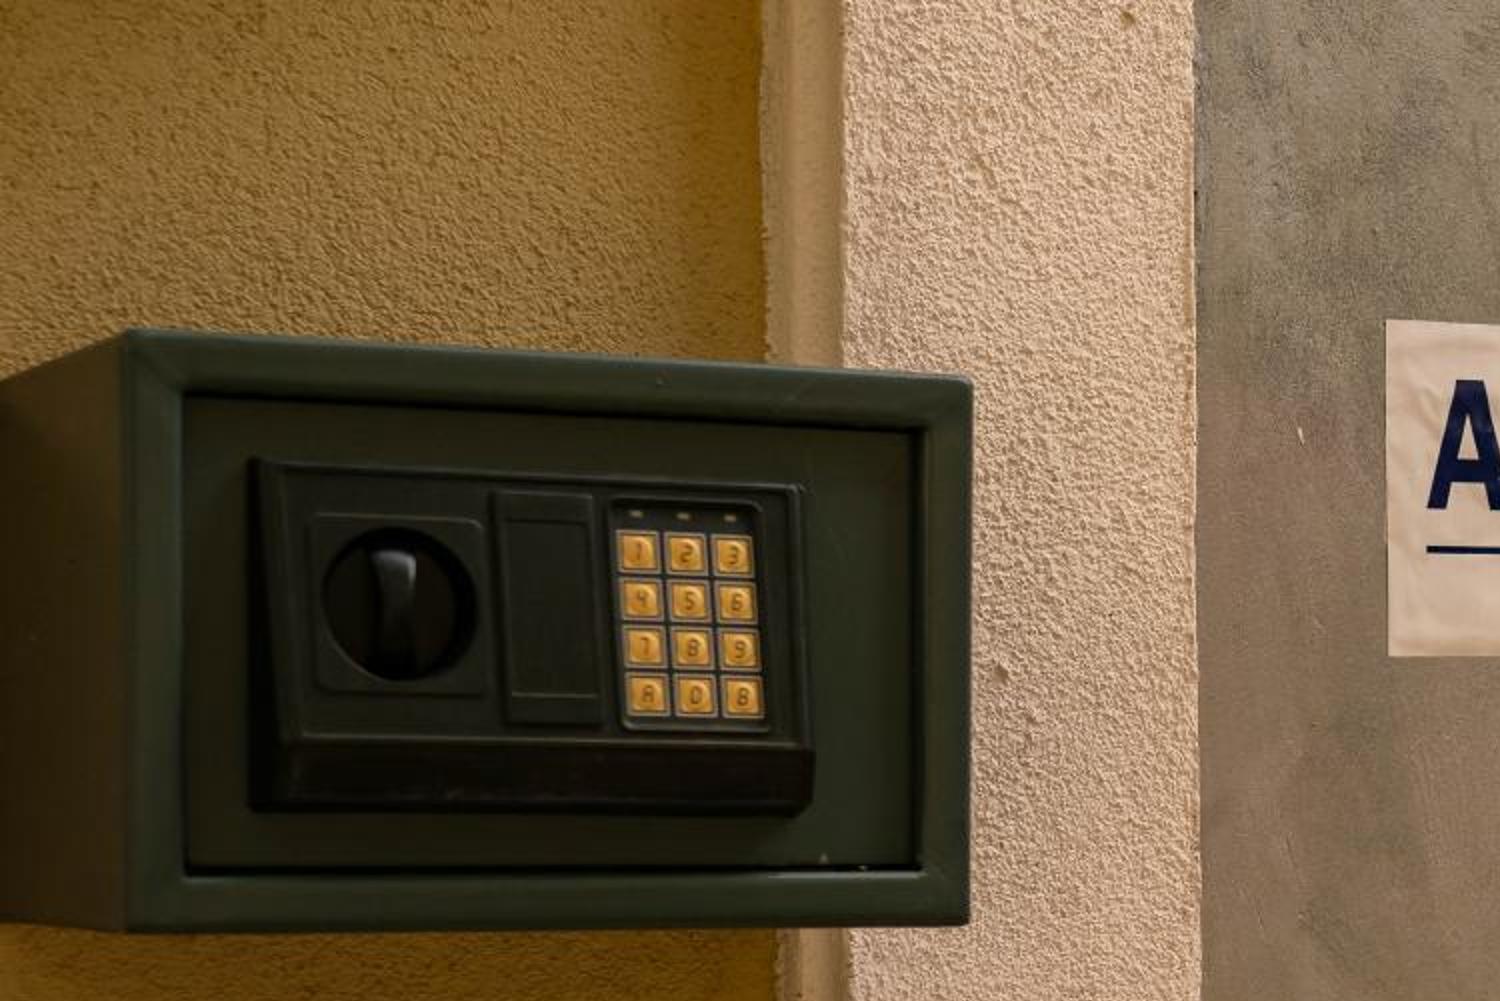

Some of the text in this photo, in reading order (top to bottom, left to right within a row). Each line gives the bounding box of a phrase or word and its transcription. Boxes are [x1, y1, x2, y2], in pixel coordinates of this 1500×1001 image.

[681, 544, 693, 564] 2
[729, 546, 740, 566] 3
[637, 590, 743, 612] 4 5 6
[688, 638, 700, 657] 8
[735, 641, 747, 659] 9
